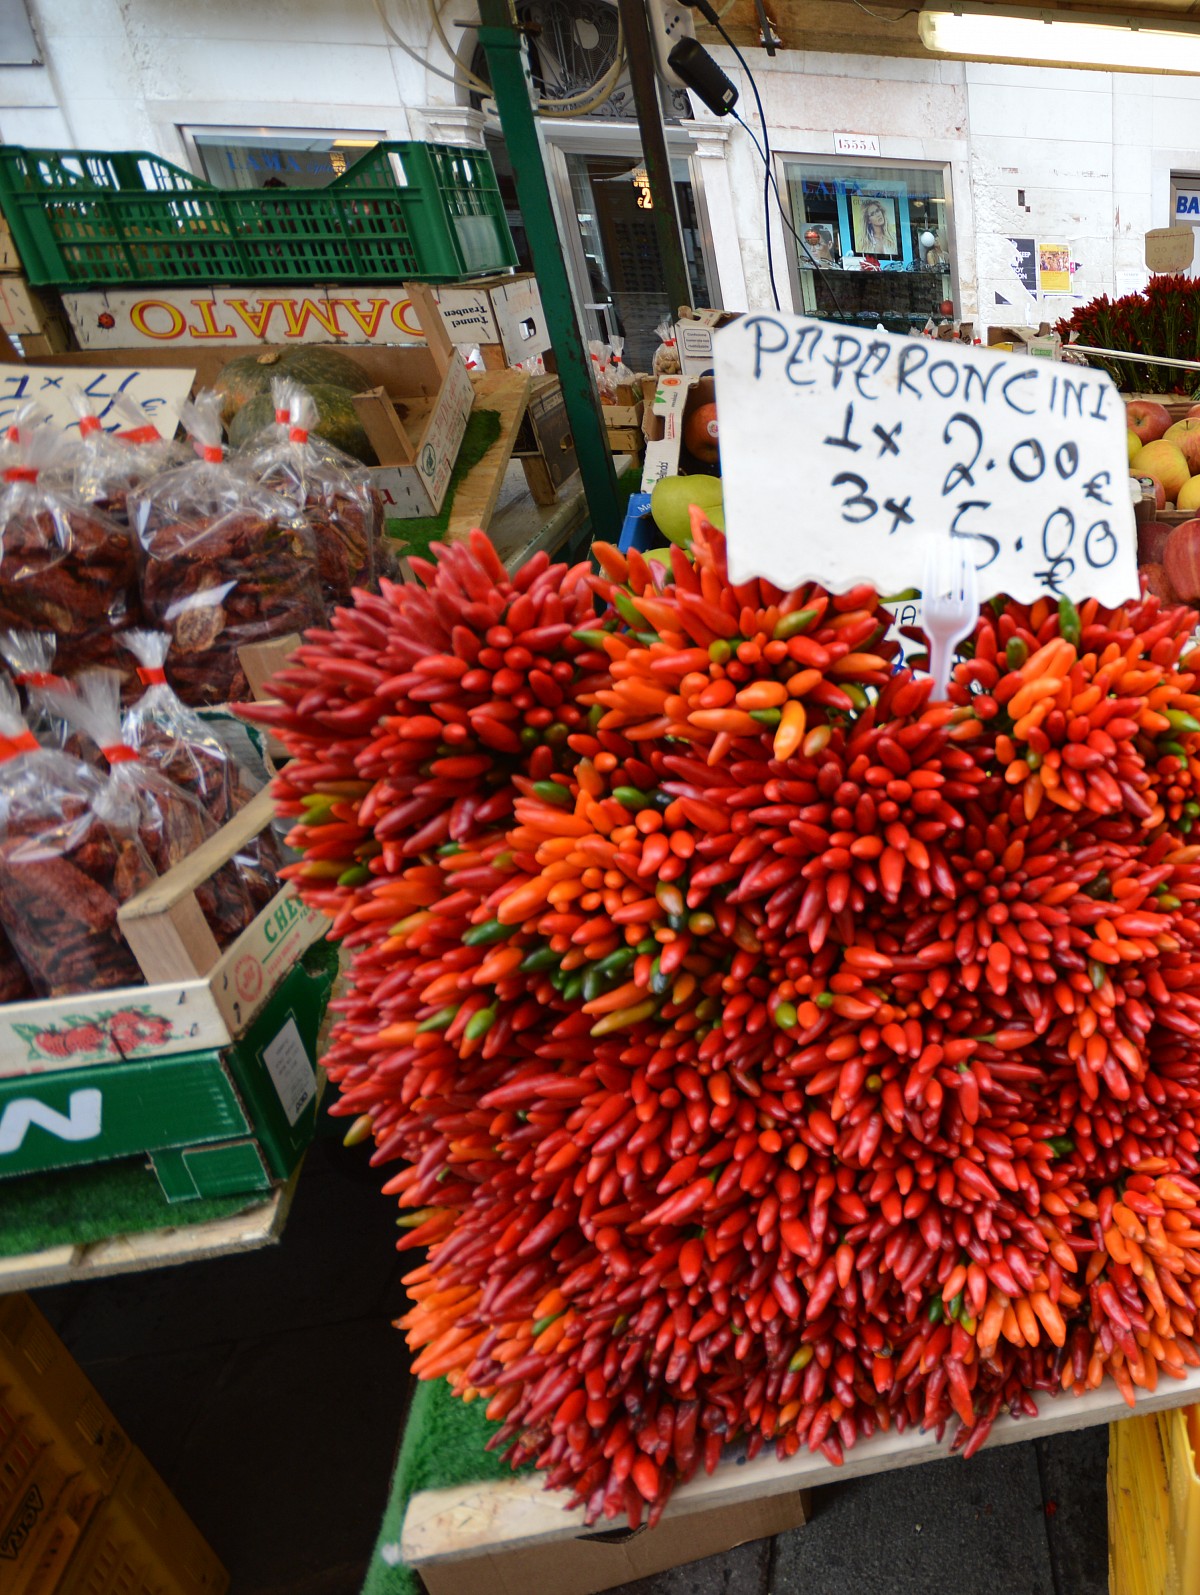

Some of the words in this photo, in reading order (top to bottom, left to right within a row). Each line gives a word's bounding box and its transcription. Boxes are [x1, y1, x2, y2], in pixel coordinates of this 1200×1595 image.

[443, 306, 488, 318] Trauben
[451, 316, 489, 328] Tunnel
[743, 314, 1110, 421] PEPERONCINI
